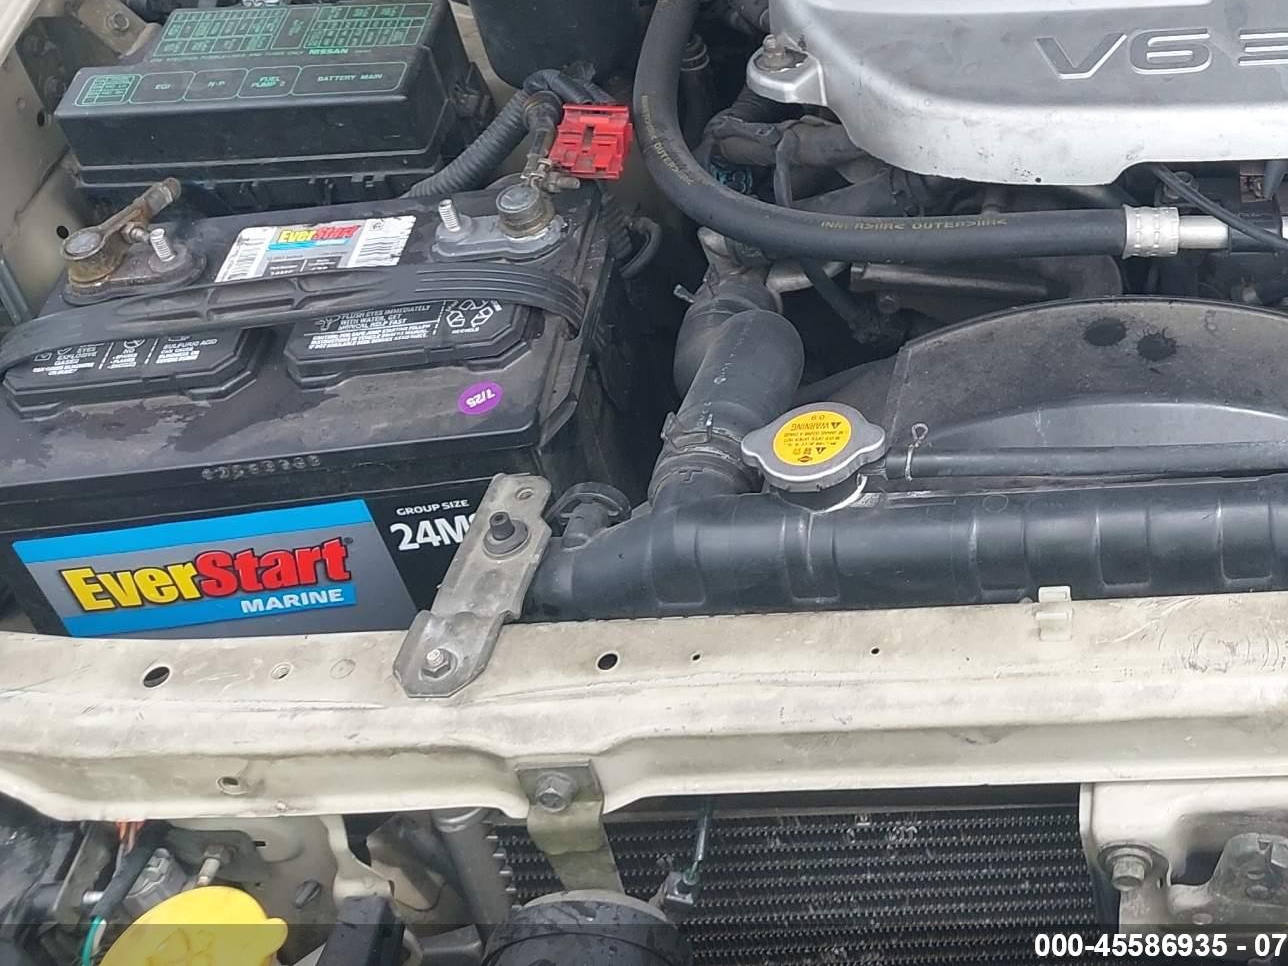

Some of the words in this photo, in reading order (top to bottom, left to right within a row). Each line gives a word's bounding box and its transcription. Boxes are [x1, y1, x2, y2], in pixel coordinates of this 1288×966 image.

[1035, 30, 1211, 80] V6
[317, 74, 355, 82] BATTERY
[277, 224, 362, 244] EverStart
[384, 305, 431, 315] IMMEDIATELY
[388, 318, 408, 326] FAST
[162, 340, 200, 350] SULFURIC
[200, 338, 218, 346] ACID
[465, 388, 496, 409] 7/25
[790, 421, 829, 432] WARNING
[396, 503, 441, 516] GROUP
[441, 499, 470, 510] SIZE
[389, 514, 476, 551] 24M
[60, 536, 354, 614] EverStart
[240, 588, 345, 614] MARINE
